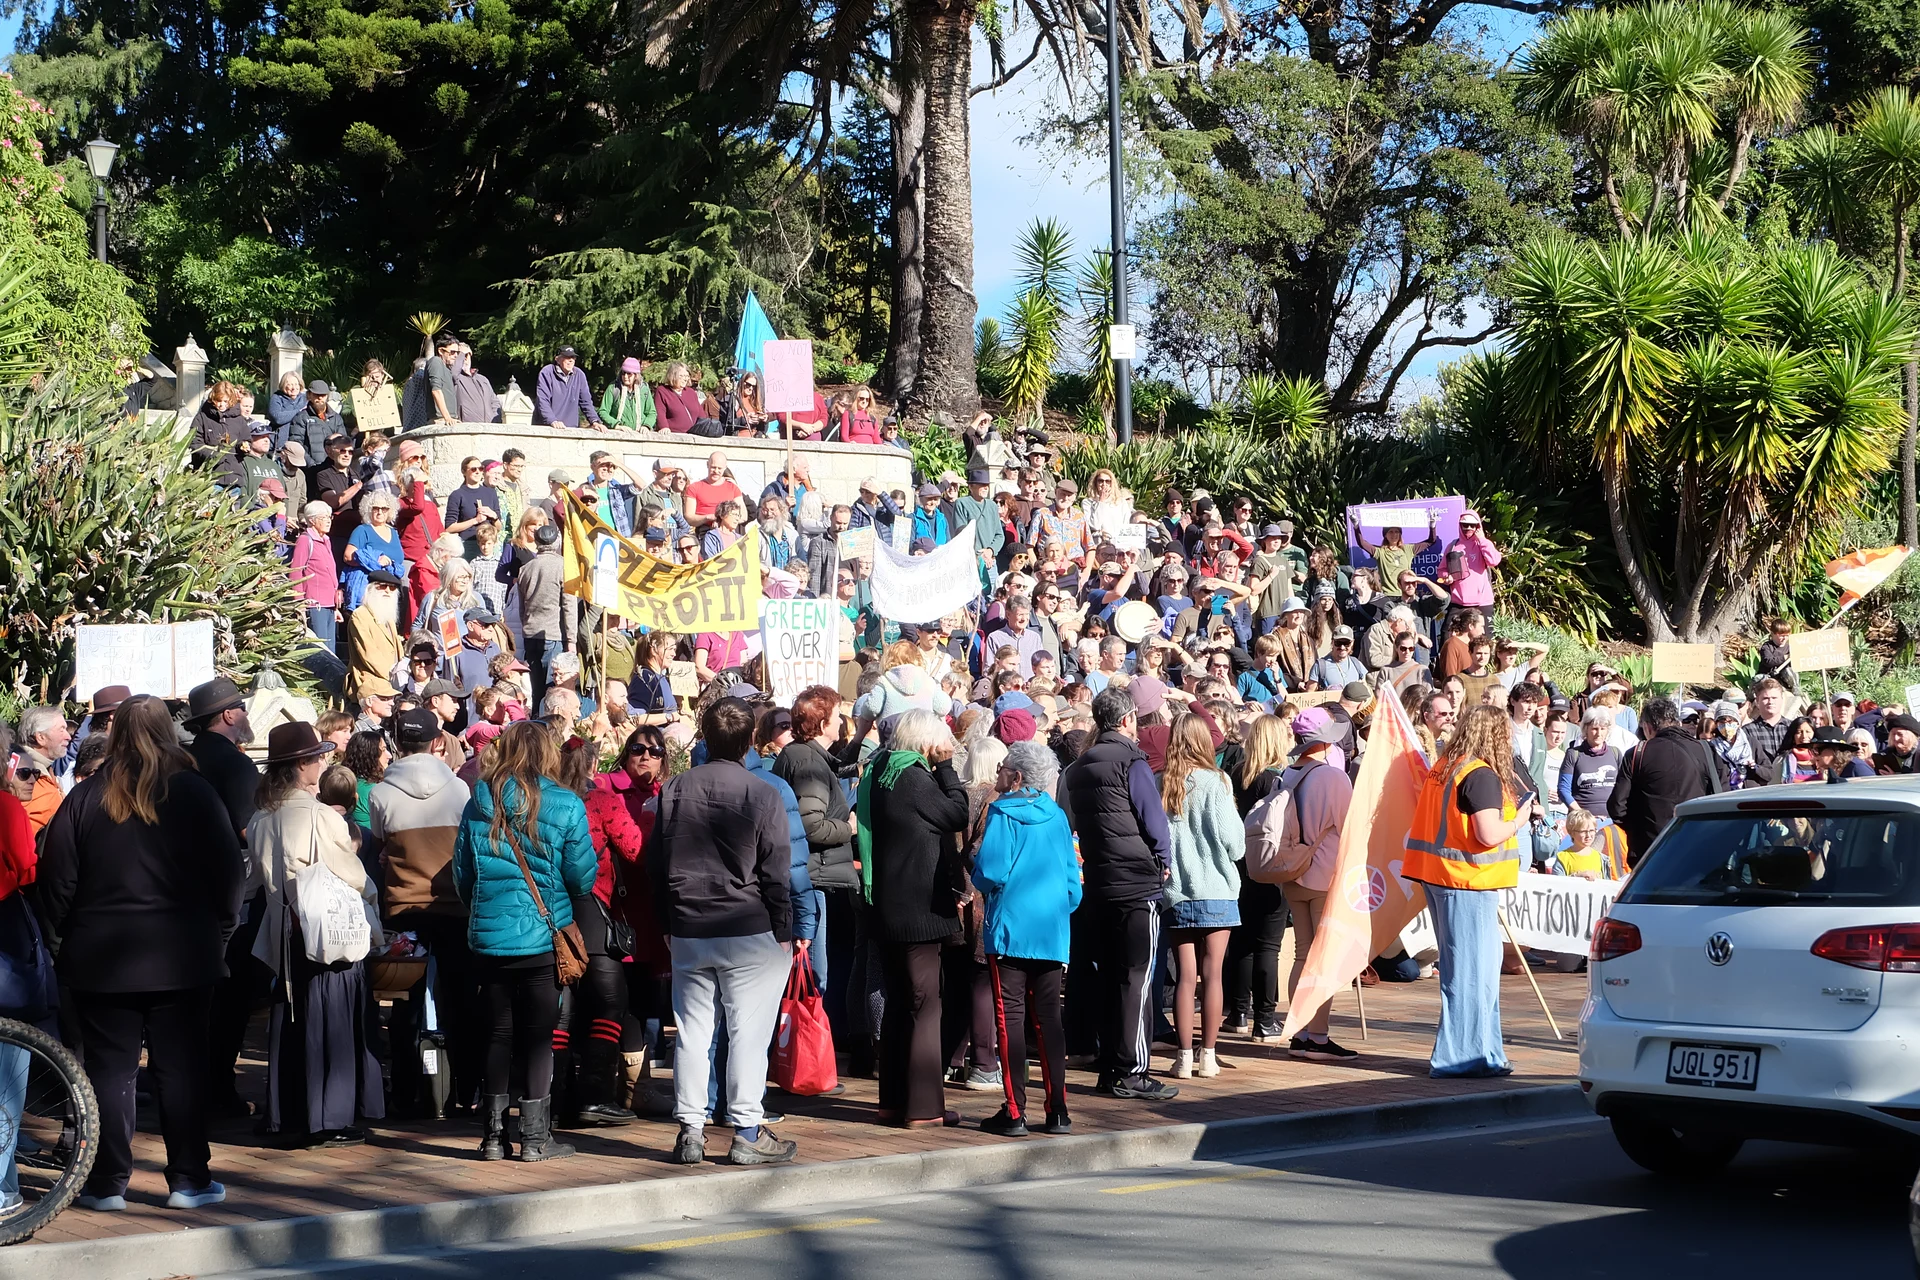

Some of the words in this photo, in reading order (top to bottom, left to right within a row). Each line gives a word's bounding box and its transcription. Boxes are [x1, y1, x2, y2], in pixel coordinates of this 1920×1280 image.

[788, 342, 808, 356] NOT
[766, 378, 785, 393] FOR
[362, 397, 381, 407] KILL
[788, 395, 813, 407] SALE
[366, 416, 386, 427] BILL
[623, 575, 746, 628] PROFIT
[765, 599, 827, 629] GREEN
[780, 631, 821, 660] OVER
[1808, 642, 1837, 655] VOTE
[1800, 655, 1822, 668] FOR
[1823, 652, 1847, 667] THIS
[328, 930, 350, 940] TAYLOR
[351, 930, 366, 940] SWIFT
[1604, 977, 1630, 987] GOLF
[1672, 1050, 1750, 1080] JQL951
